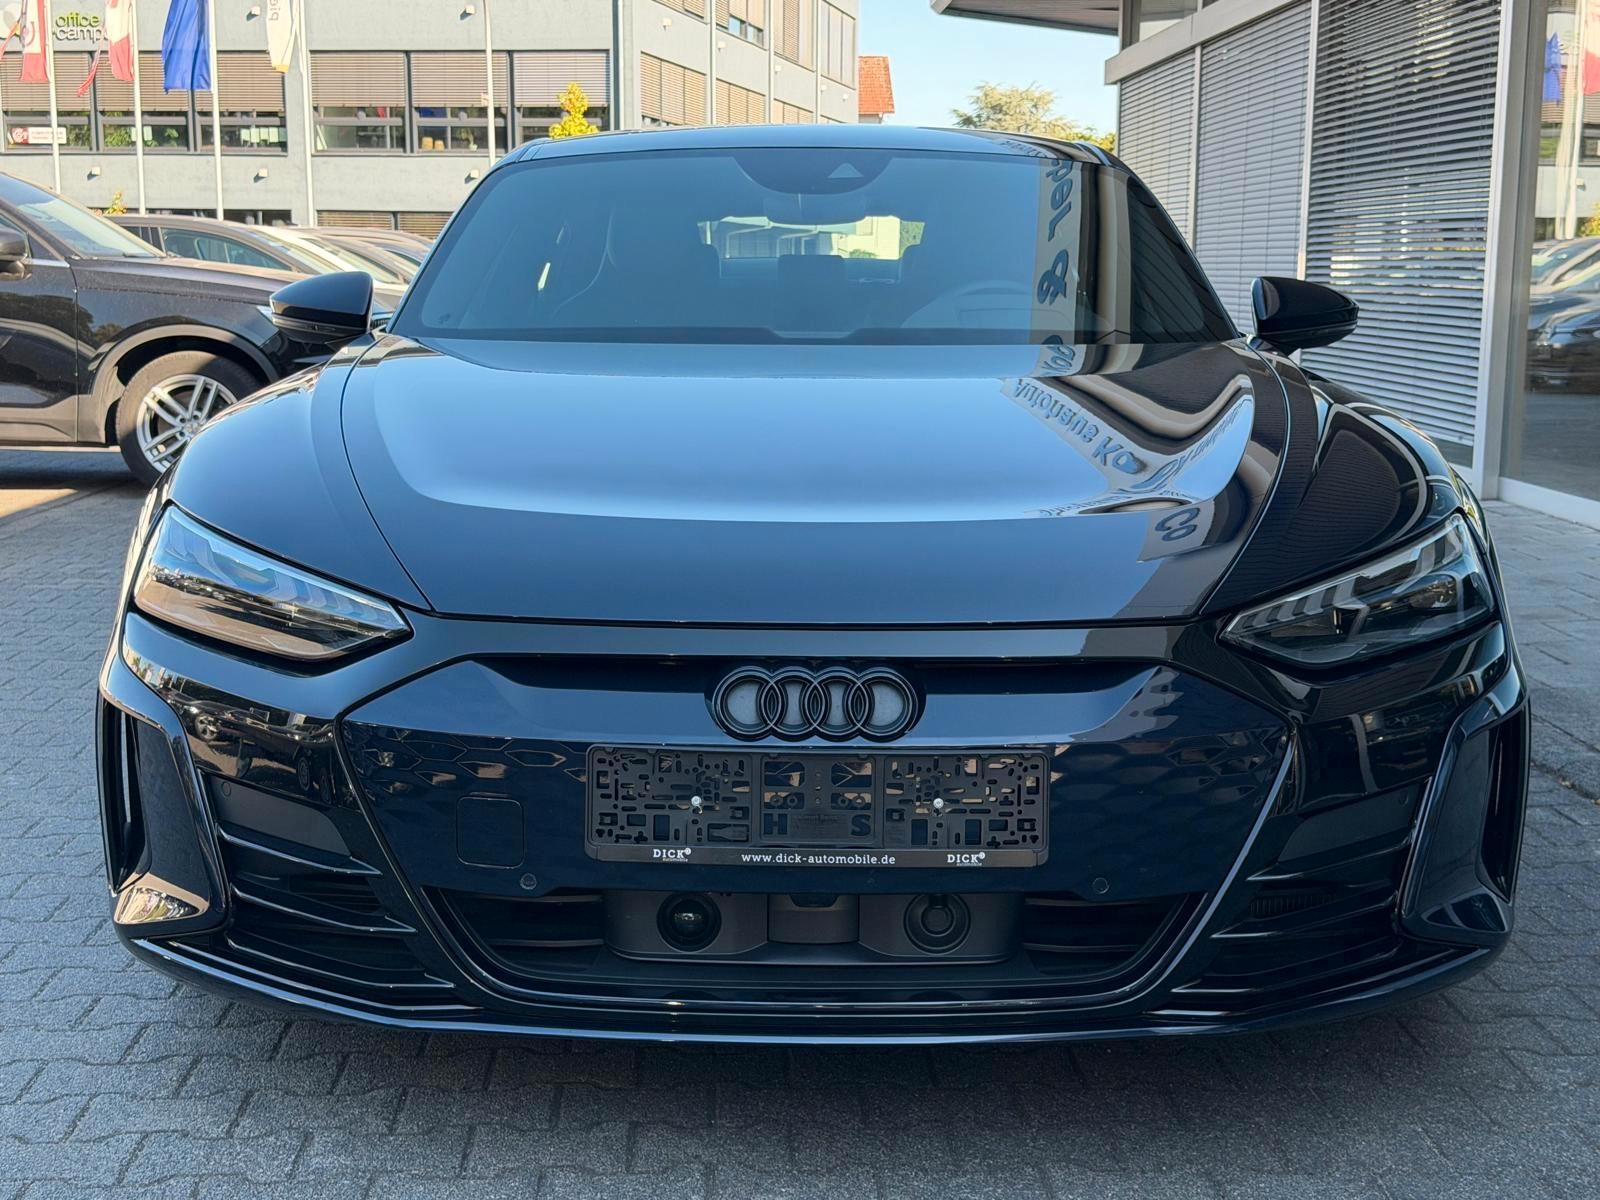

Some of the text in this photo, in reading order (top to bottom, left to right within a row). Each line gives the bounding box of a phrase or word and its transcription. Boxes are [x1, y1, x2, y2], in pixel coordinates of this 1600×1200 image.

[55, 11, 100, 28] office
[653, 848, 685, 859] DICK
[741, 853, 896, 865] www.dick-automobile.de
[946, 853, 979, 863] DICK
